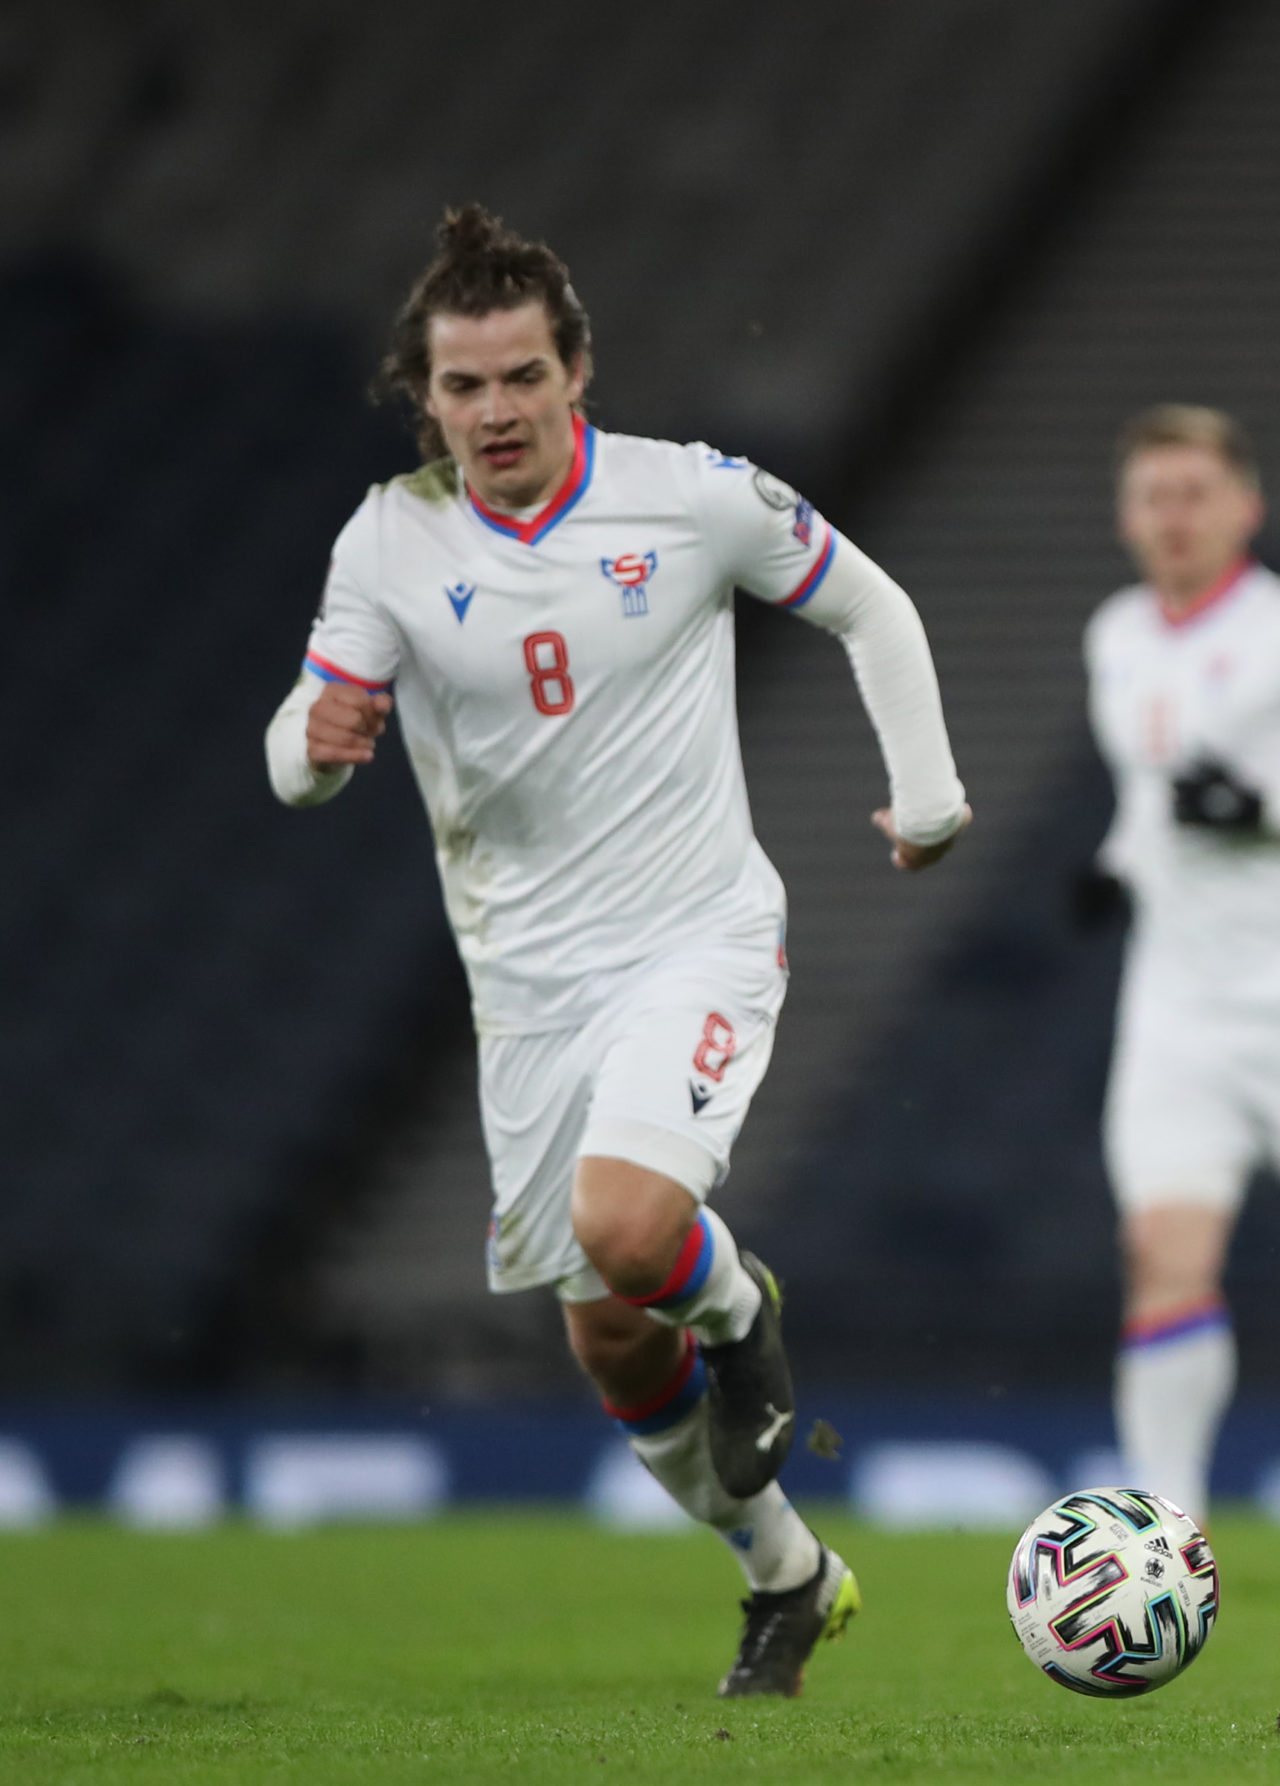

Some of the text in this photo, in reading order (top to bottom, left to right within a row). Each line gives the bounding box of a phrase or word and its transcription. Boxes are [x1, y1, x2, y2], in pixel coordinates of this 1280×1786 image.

[523, 630, 575, 717] 8
[692, 1010, 737, 1084] 8
[1144, 1543, 1173, 1559] adidas
